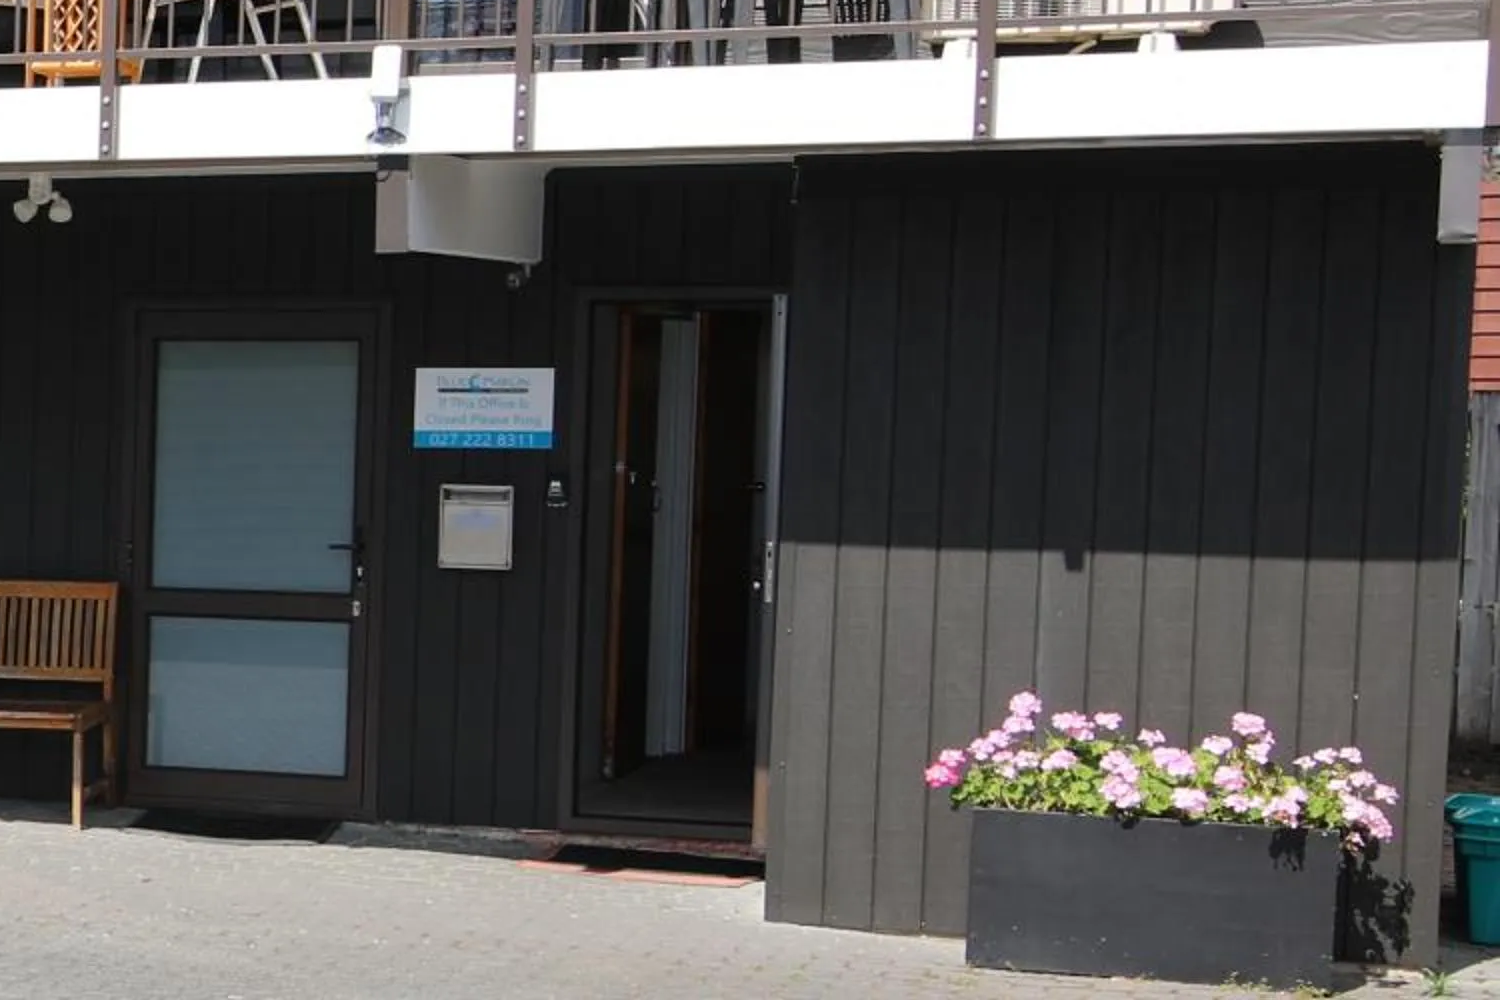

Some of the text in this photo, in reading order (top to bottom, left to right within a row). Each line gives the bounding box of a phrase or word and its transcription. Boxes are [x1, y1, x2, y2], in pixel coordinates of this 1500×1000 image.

[428, 433, 533, 446] 027 222 8311
